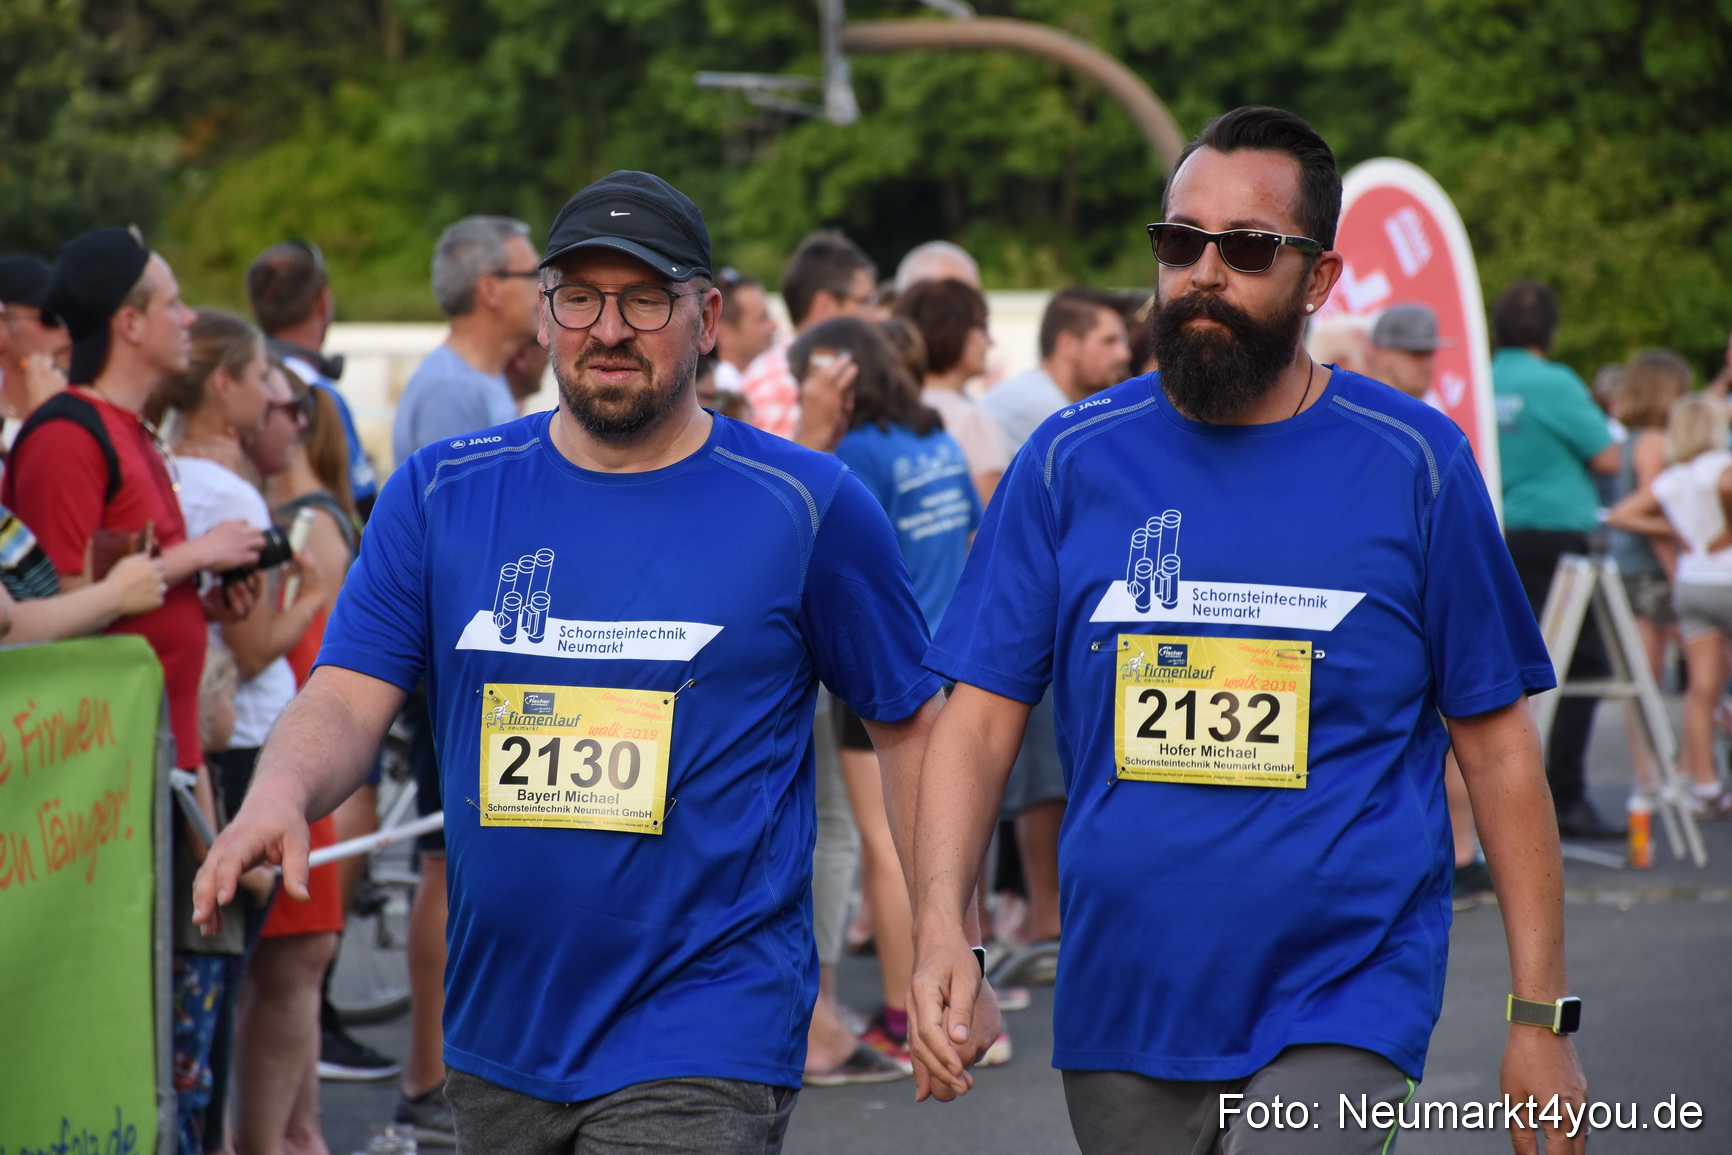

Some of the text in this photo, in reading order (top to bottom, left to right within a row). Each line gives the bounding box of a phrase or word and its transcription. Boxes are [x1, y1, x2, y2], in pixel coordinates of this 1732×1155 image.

[1078, 398, 1112, 411] JAKO
[468, 435, 502, 446] JAKO
[1192, 588, 1328, 609] Schornsteintechnik
[1192, 604, 1261, 619] Neumarkt
[559, 625, 686, 640] Schornsteintechnik
[557, 639, 624, 654] Neumarkt
[1144, 663, 1216, 680] firmenlauf
[1223, 674, 1297, 692] walk 2019
[508, 712, 582, 728] firmenlauf
[1136, 688, 1281, 744] 2132
[13, 697, 117, 777] Firmen
[588, 722, 658, 740] walk 2019
[1159, 743, 1257, 759] Hofer Michael
[499, 735, 641, 791] 2130
[1125, 756, 1295, 772] Schornsteintechnik Neumarkt GmbH
[517, 789, 620, 805] Bayerl Michael
[487, 803, 652, 819] Schornsteintechnik Neumarkt GmbH
